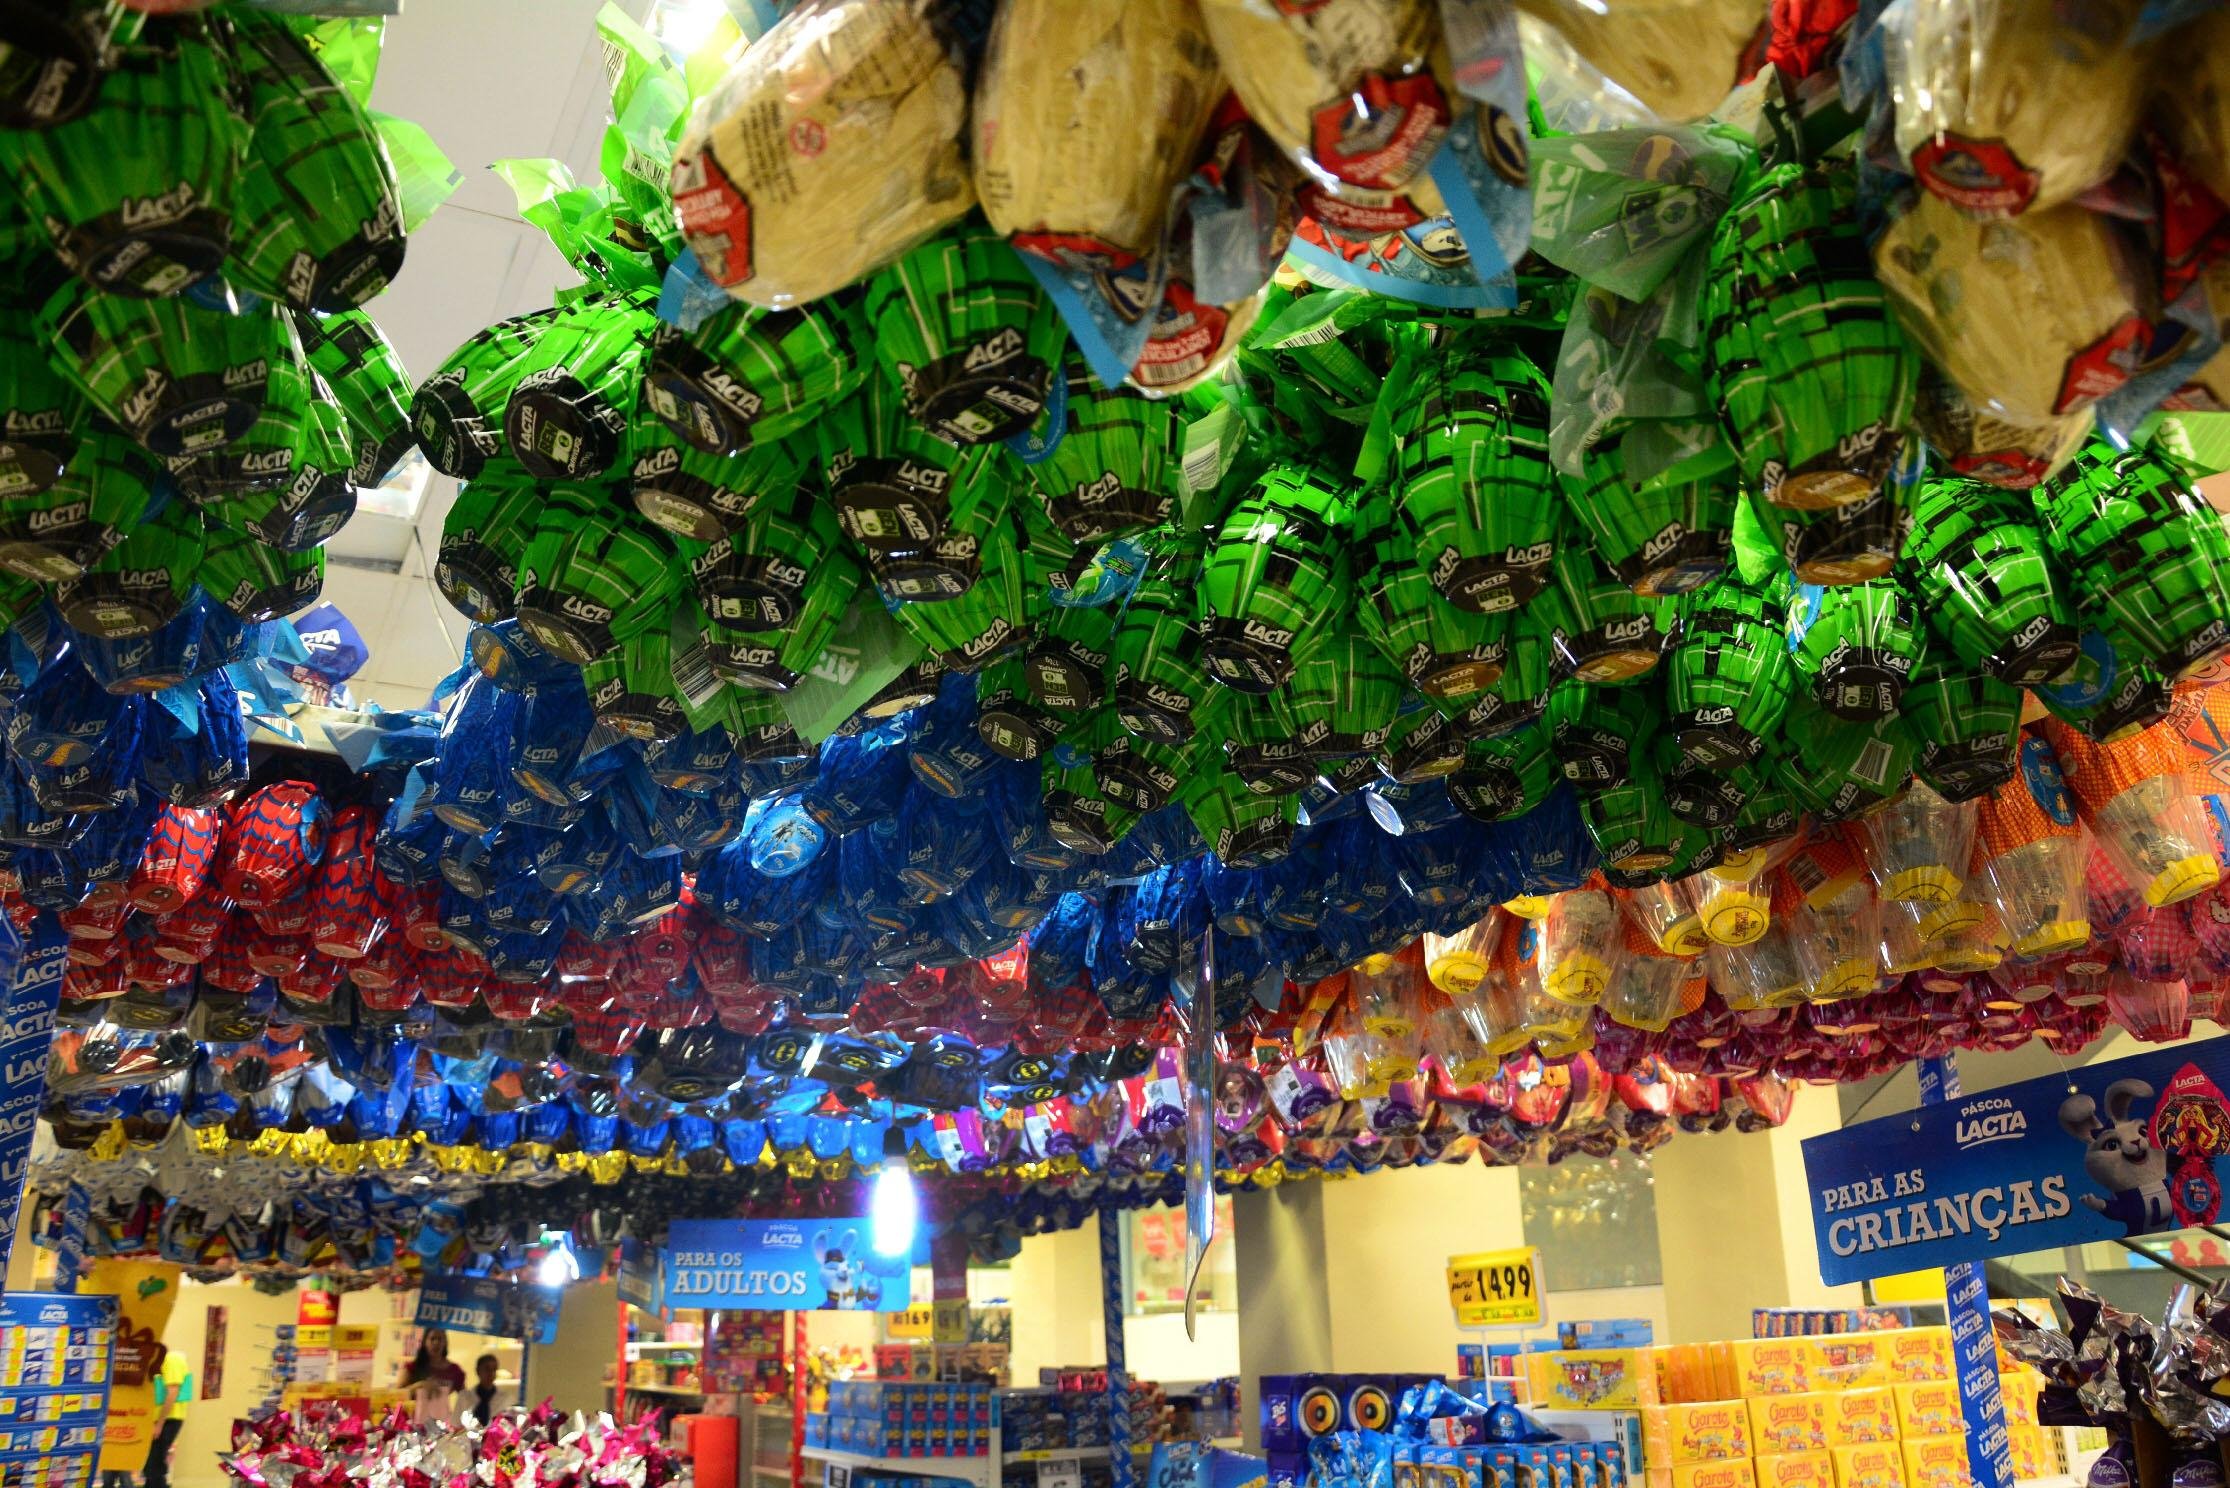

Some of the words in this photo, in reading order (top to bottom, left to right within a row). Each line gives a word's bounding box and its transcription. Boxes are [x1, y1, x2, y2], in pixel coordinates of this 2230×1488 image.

[121, 181, 195, 224] LACTA
[331, 254, 378, 294] LACTA
[223, 359, 267, 384] LACTA
[703, 366, 762, 415] LACTA
[985, 385, 1039, 412] LACTA
[6, 410, 64, 431] LACTA
[170, 401, 229, 429] LACTA
[520, 406, 534, 450] LACTA
[538, 421, 555, 454] BEN
[553, 430, 572, 458] 10
[241, 449, 292, 471] LACTA
[635, 449, 679, 476] ACTA
[281, 465, 318, 510] LACTA
[899, 460, 948, 491] LACT
[29, 503, 87, 529] LACTA
[896, 503, 930, 541] LACTA
[1505, 543, 1553, 565] LACTA
[766, 557, 806, 586] LACT
[1464, 573, 1510, 595] LACTA
[722, 598, 740, 619] 10
[759, 596, 781, 624] LACTA
[300, 629, 340, 647] CTA
[963, 619, 1010, 657] LACTA
[1605, 614, 1651, 641] LACT
[1070, 641, 1108, 667] LACTA
[1041, 668, 1066, 680] 10
[1431, 667, 1475, 686] LACTA
[1044, 697, 1076, 708] LACTA
[1147, 685, 1190, 710] LACTA
[1468, 692, 1500, 724] ACTA
[1844, 686, 1860, 708] 10
[1878, 682, 1893, 712] LACTA
[999, 729, 1012, 748] 10
[1150, 715, 1175, 736] LACTA
[1405, 711, 1441, 747] LACTA
[1025, 736, 1041, 759] LACTA
[1261, 743, 1298, 758] LACT
[1593, 731, 1627, 752] LACTA
[1708, 737, 1741, 754] LACTA
[1147, 767, 1178, 793] LACT
[1272, 769, 1302, 784] LACTA
[1593, 755, 1610, 781] LACTA
[458, 786, 492, 802] LACT
[1107, 782, 1123, 795] 10
[1137, 788, 1149, 809] LACTA
[1690, 844, 1715, 870] LACT
[14, 957, 68, 989] LACT
[7, 1000, 47, 1016] SCOA
[6, 1053, 51, 1084] LAC
[2175, 1073, 2205, 1089] LACTA
[1945, 1084, 1960, 1100] LAC
[1961, 1098, 2012, 1118] PÁSCOA
[1955, 1110, 2027, 1144] LACTA
[1822, 1178, 1888, 1214] PARA
[1893, 1168, 1925, 1195] AS
[1828, 1175, 2071, 1257] CRIANÇAS
[763, 1232, 802, 1245] LACTA
[675, 1252, 716, 1266] PARA
[721, 1253, 742, 1266] OS
[672, 1270, 807, 1295] ADULTOS
[1945, 1263, 1972, 1282] ACTA
[1952, 1277, 1983, 1305] LACTA
[40, 1310, 69, 1321] LACTA
[1952, 1313, 1984, 1340] LACTA
[1966, 1331, 1993, 1361] LACTA
[1964, 1369, 1995, 1397] LACTA
[1980, 1393, 2003, 1419] LACT
[1979, 1427, 2007, 1456] LACTA
[1994, 1455, 2014, 1479] LAC
[2094, 1463, 2123, 1476] Milka
